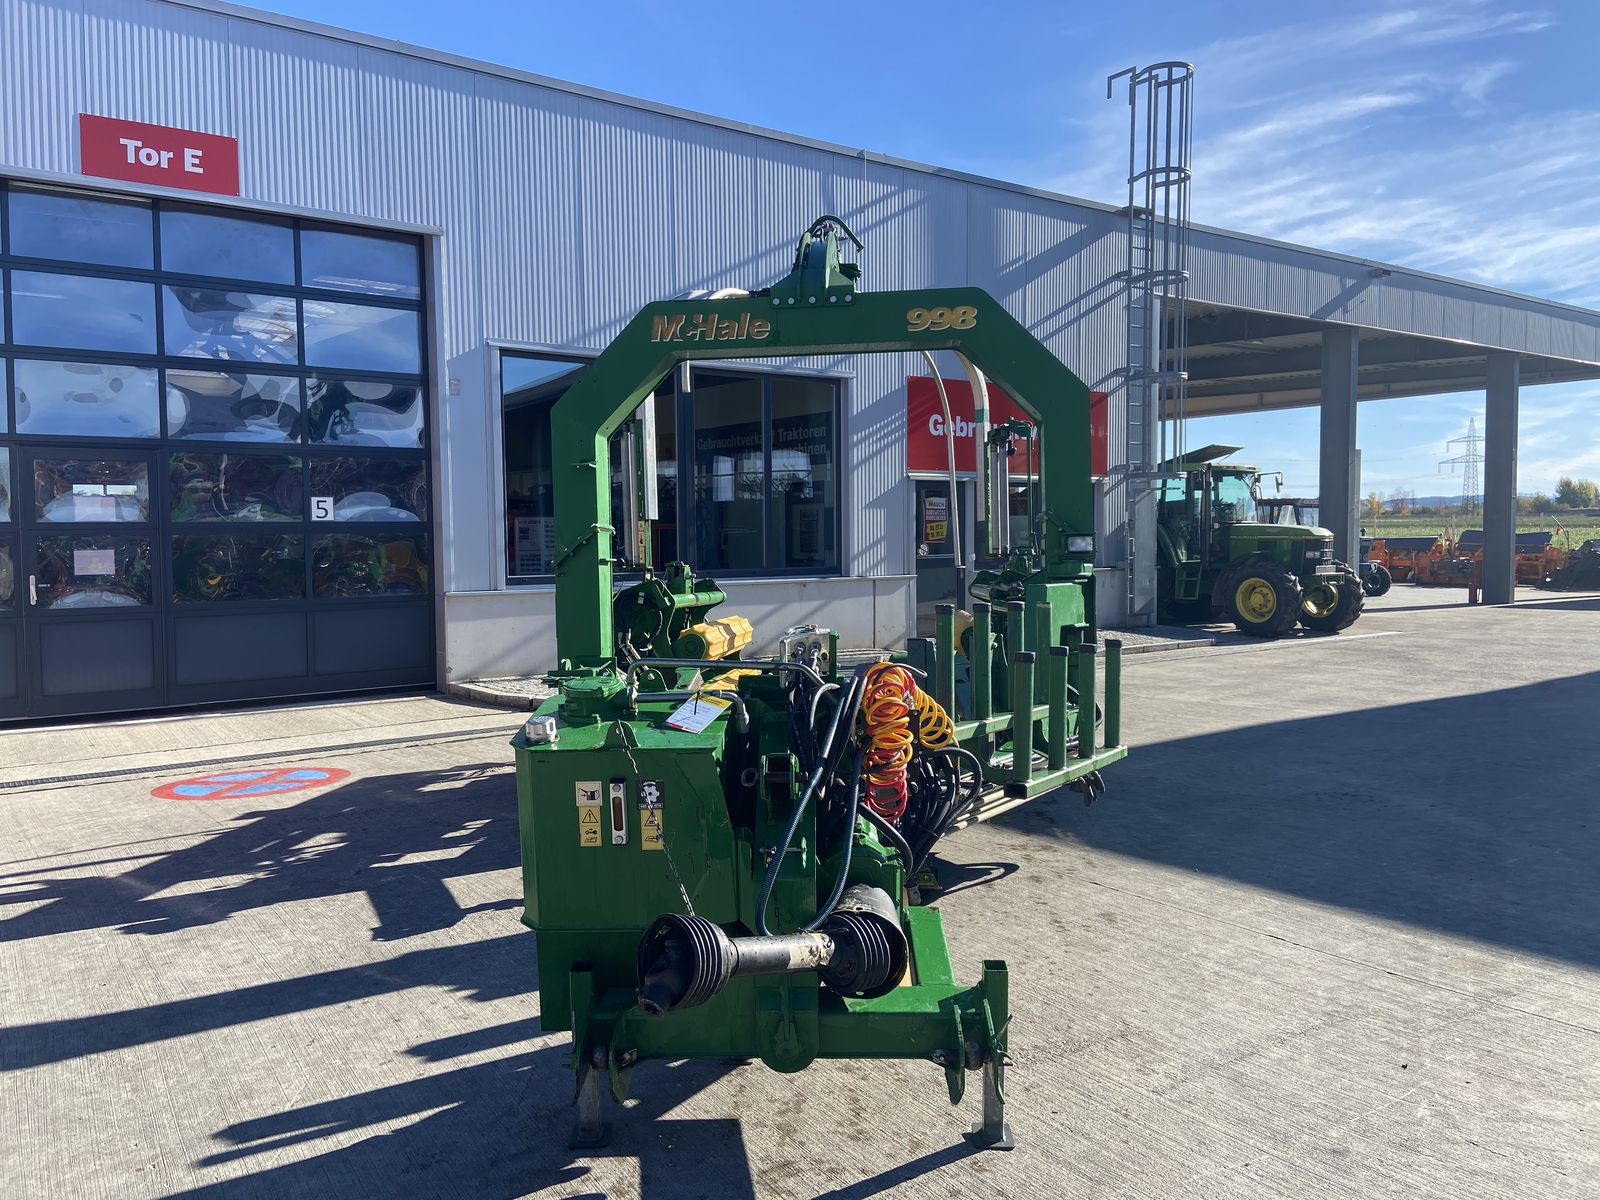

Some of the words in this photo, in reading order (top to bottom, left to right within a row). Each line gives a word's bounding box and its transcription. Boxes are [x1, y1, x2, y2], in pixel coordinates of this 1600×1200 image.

[119, 137, 174, 169] Tor
[183, 147, 204, 174] E
[906, 305, 978, 331] 998
[776, 424, 826, 442] Traktoren
[315, 500, 329, 519] 5
